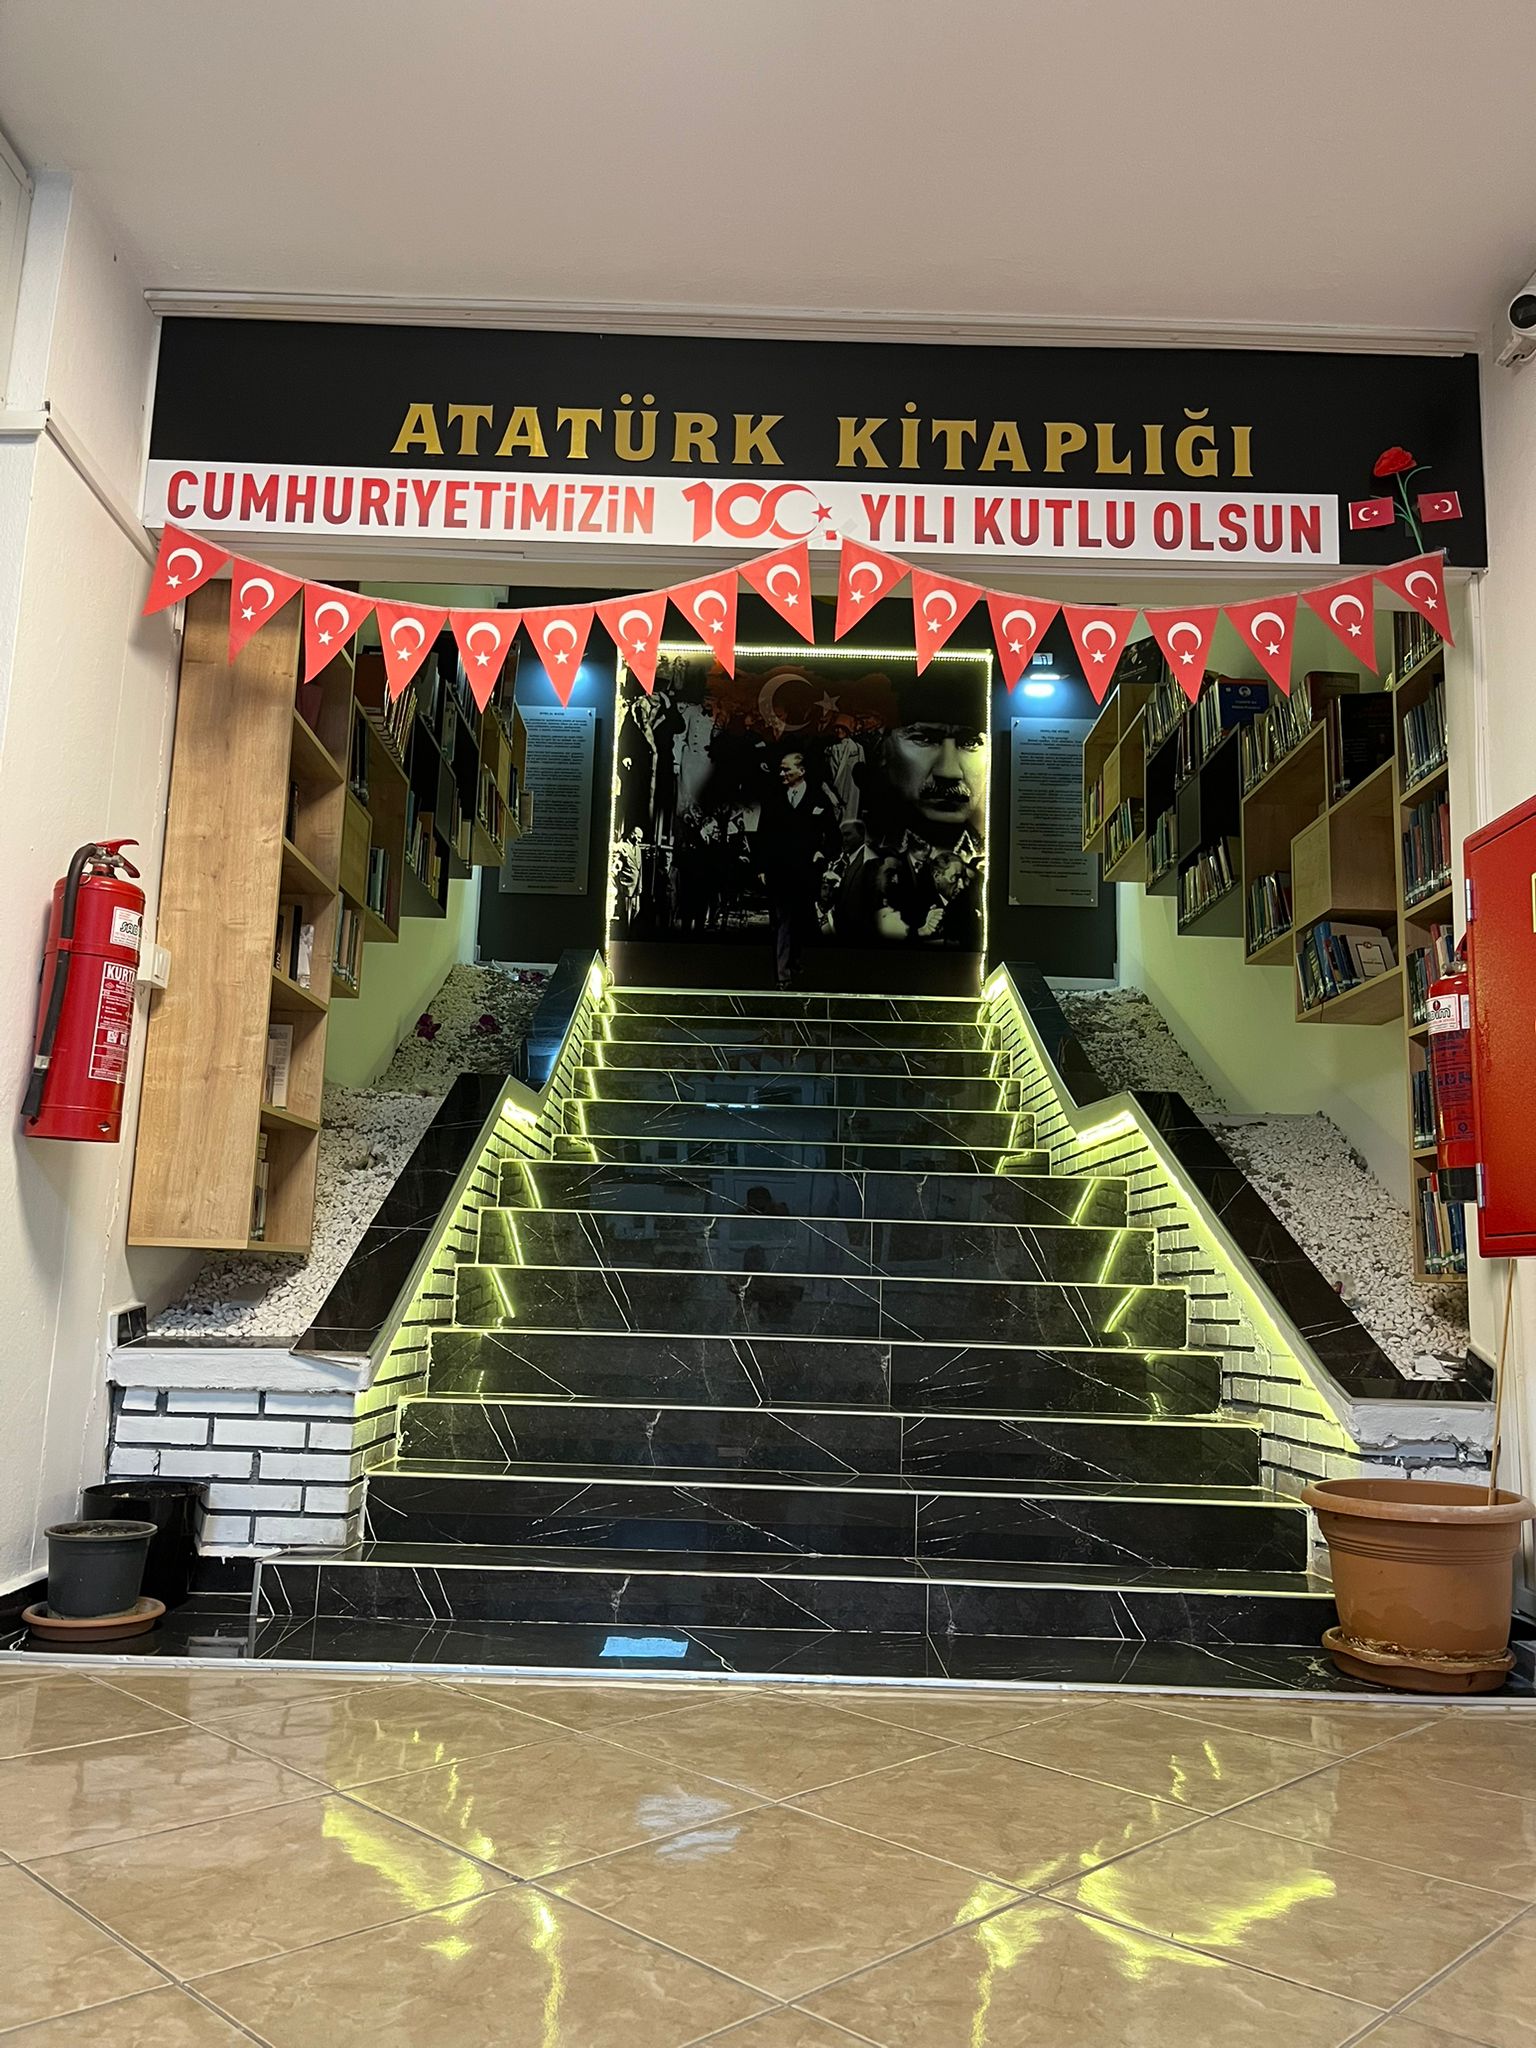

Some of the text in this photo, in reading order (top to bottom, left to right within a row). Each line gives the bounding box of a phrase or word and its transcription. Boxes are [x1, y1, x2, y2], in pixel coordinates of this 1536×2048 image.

[391, 393, 1253, 478] ATATÜRK KİTAPLIĞI
[859, 494, 955, 544] YILI
[974, 497, 1136, 549] KUTLU
[1153, 502, 1322, 554] OLSUN
